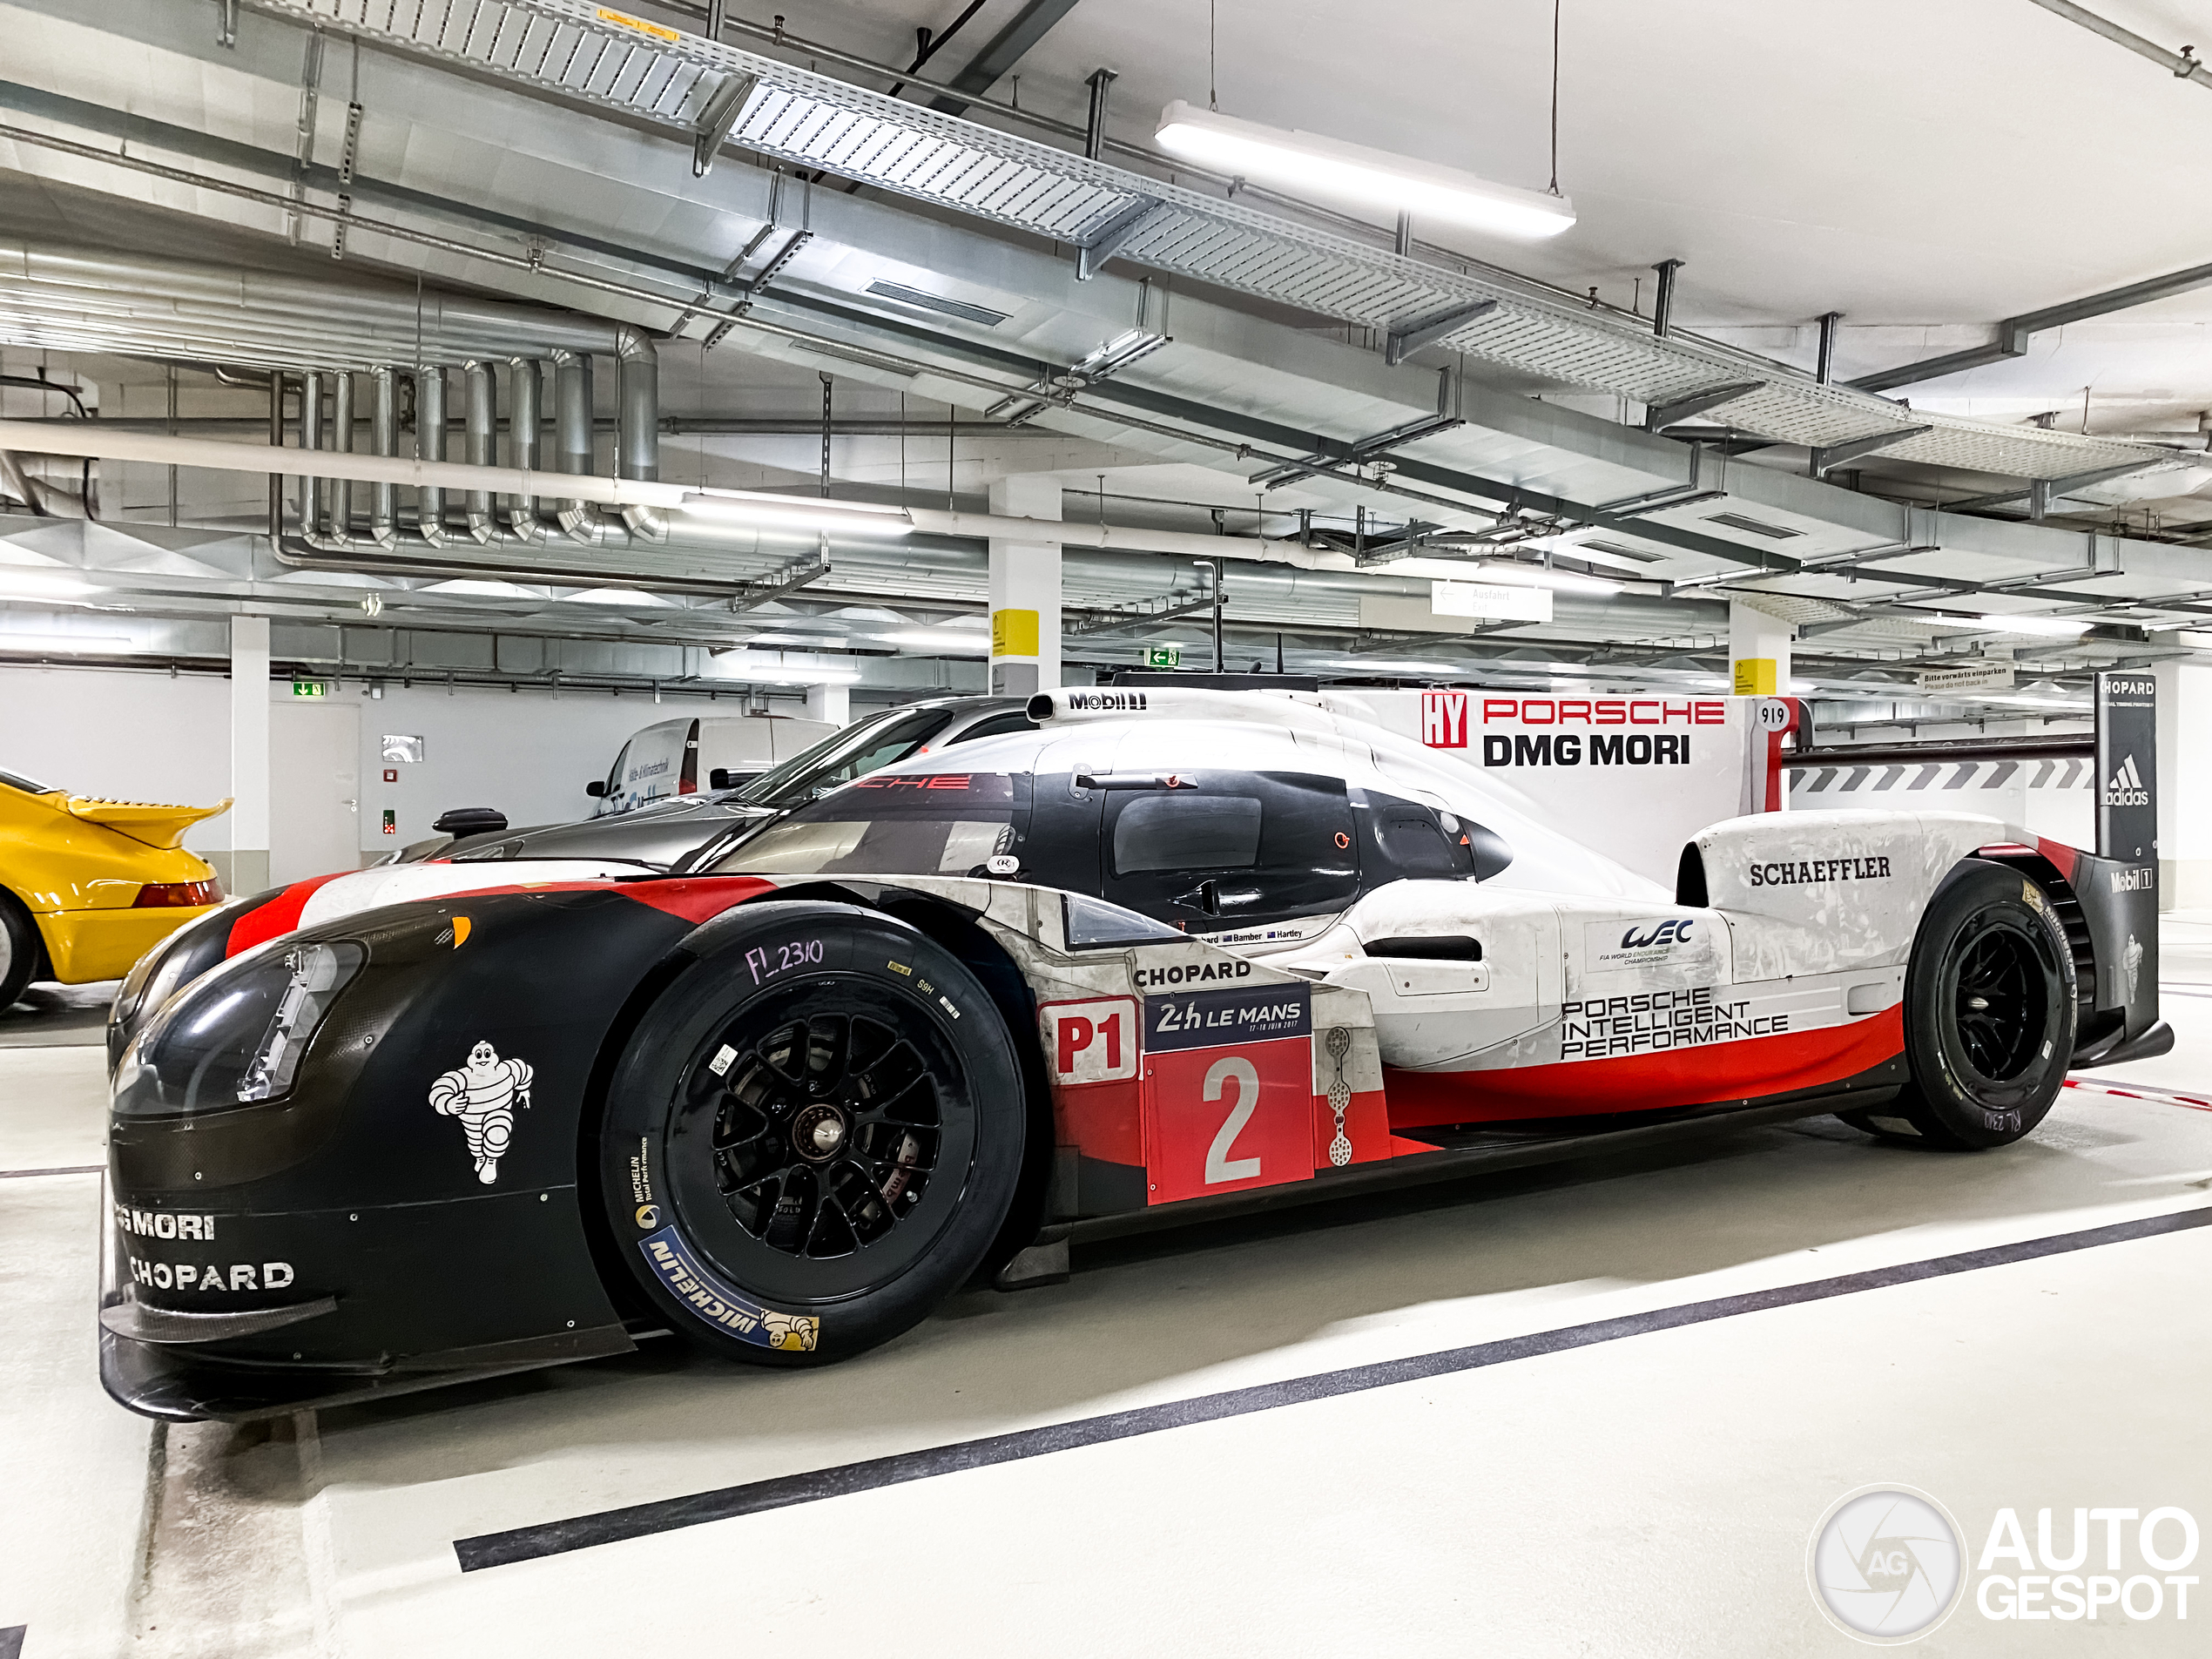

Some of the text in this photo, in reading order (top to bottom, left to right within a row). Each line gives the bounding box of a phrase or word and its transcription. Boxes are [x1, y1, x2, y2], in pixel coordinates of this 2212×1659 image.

[1472, 589, 1510, 601] Ausfahrt
[1473, 602, 1488, 612] Exit
[1972, 668, 2006, 678] einparken
[2100, 680, 2155, 695] CHOPARD
[1423, 694, 1467, 745] HY
[1483, 699, 1725, 725] PORSCHE
[1761, 707, 1785, 725] 919
[1483, 734, 1690, 766] DMG MORI
[2105, 787, 2149, 806] adidas
[1750, 856, 1892, 887] SCHAEFFLER
[2110, 870, 2140, 894] Mobil
[1233, 933, 1263, 941] Bamber
[1277, 929, 1303, 939] Hartley
[1621, 920, 1694, 949] WEC
[1610, 952, 1633, 961] WORLD
[1133, 961, 1251, 988] CHOPARD
[1205, 1009, 1235, 1028] LE
[1238, 1003, 1301, 1024] MANS
[1561, 987, 1711, 1017] PORSCHE
[1267, 1022, 1282, 1031] JUIN
[1283, 1020, 1298, 1029] 2017
[1562, 1001, 1750, 1041] INTELLIGENT
[1057, 1013, 1121, 1074] P1
[1561, 1015, 1789, 1060] PERFORMANCE
[1203, 1056, 1262, 1185] 2
[630, 1157, 644, 1203] MICHELIN
[130, 1256, 295, 1291] CHOPARD
[649, 1240, 759, 1334] MICHELIN
